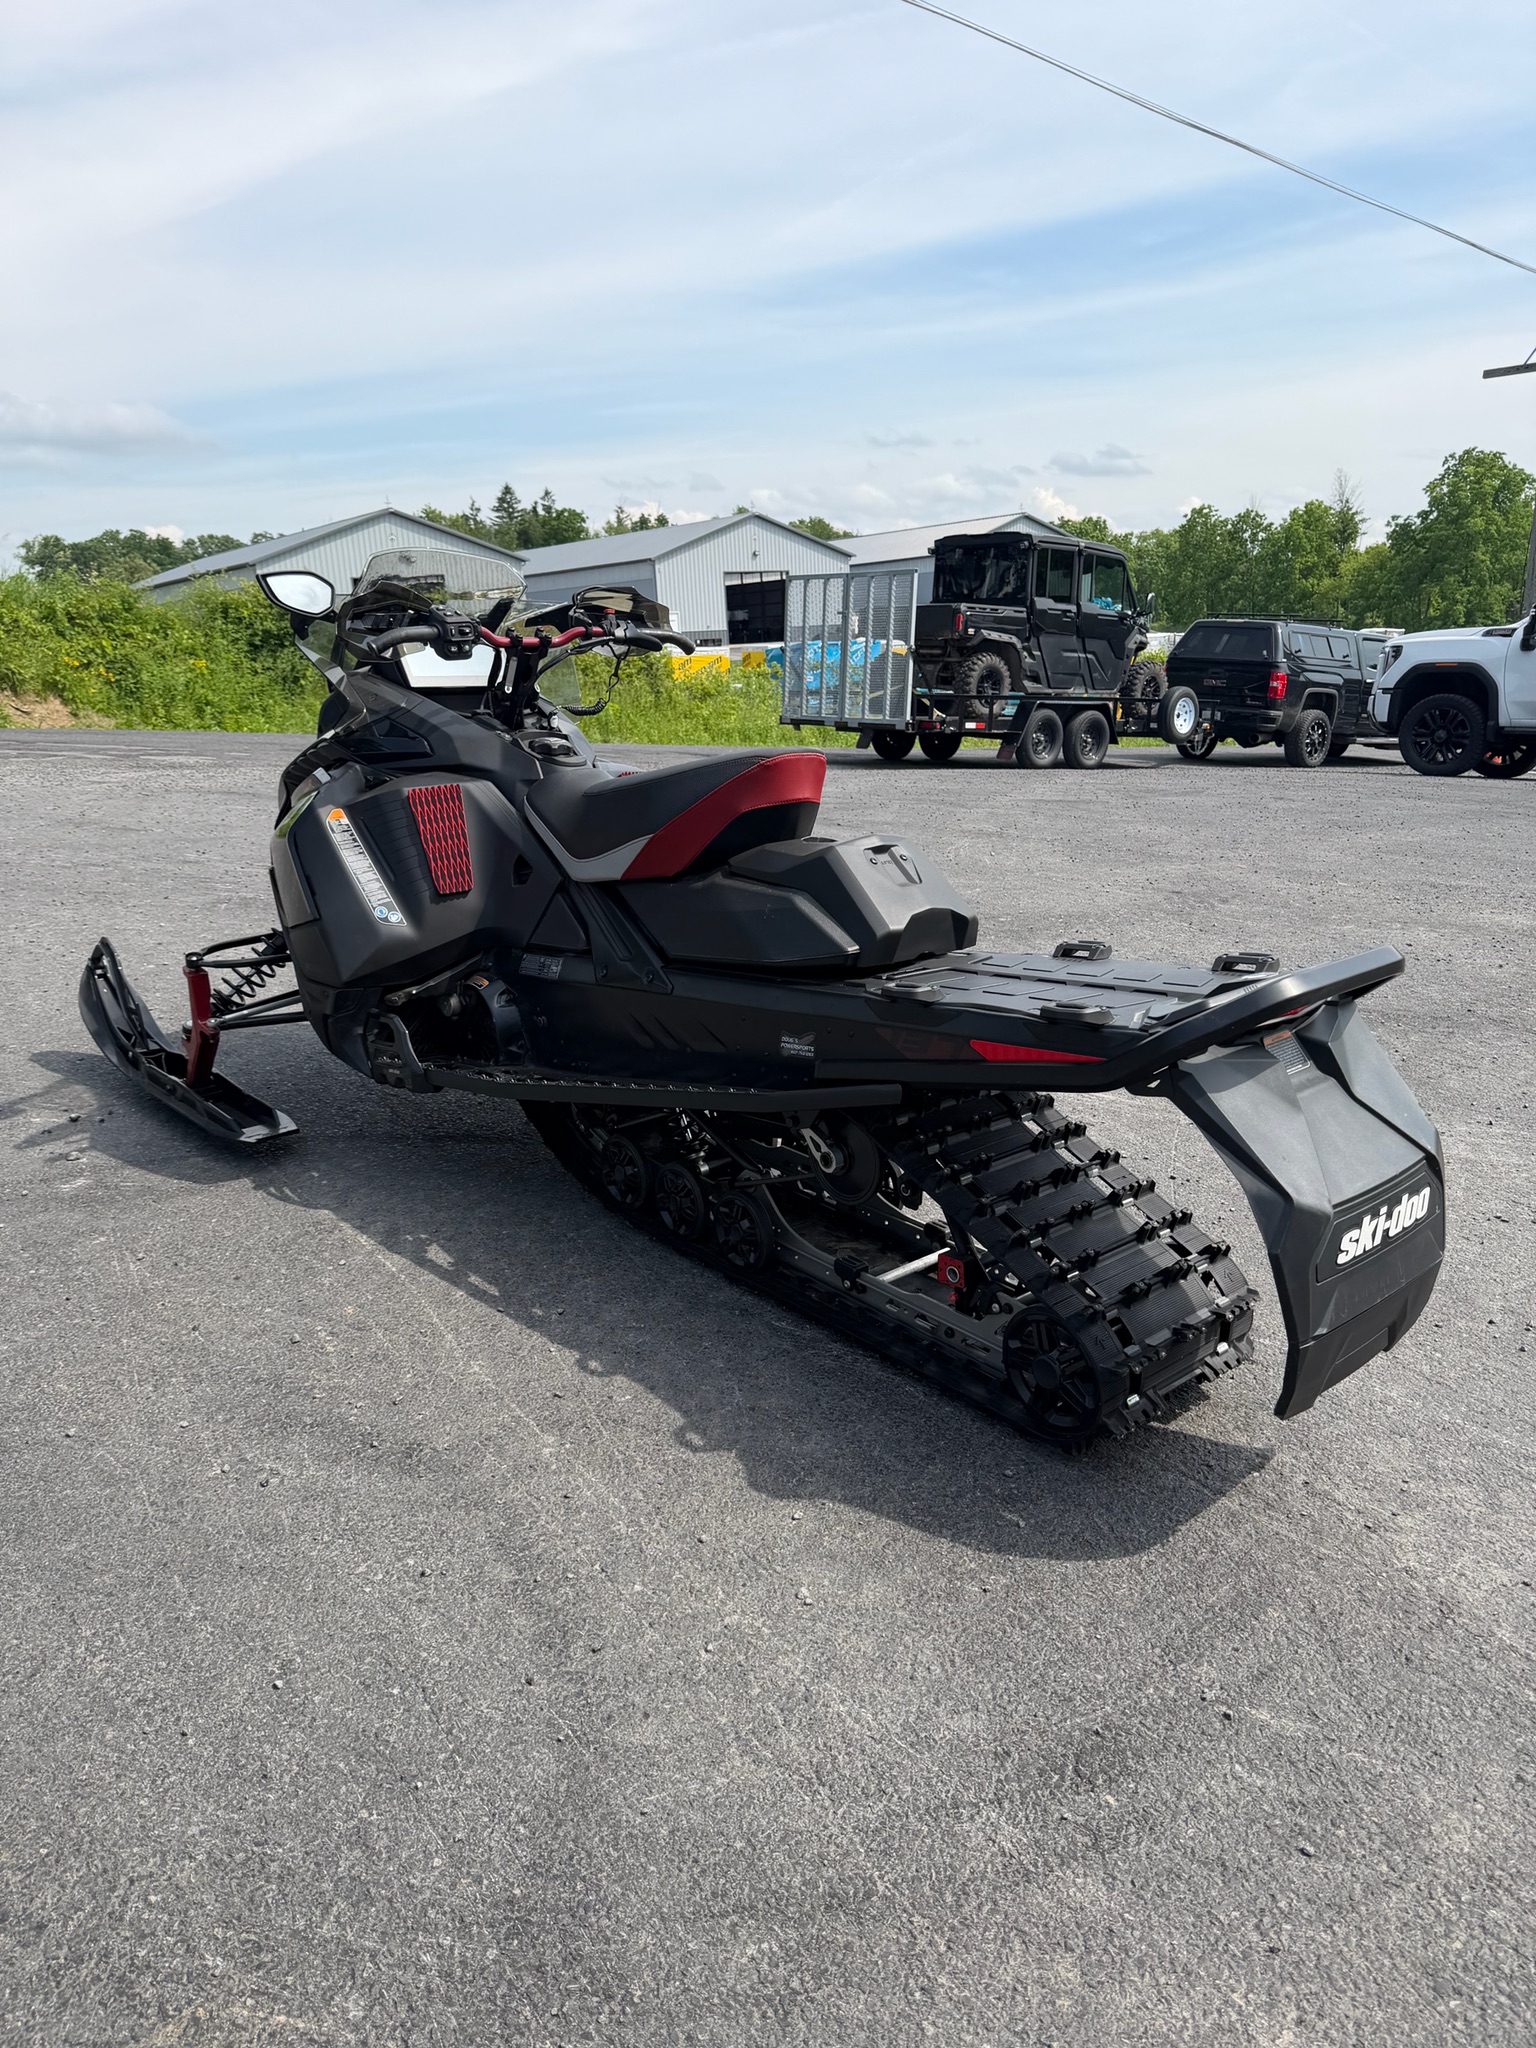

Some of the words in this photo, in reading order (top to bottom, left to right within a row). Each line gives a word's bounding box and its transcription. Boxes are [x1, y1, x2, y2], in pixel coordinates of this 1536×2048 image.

[1203, 679, 1227, 687] GMC
[780, 1042, 815, 1052] POWERSPORTS
[1336, 1186, 1431, 1265] ski-doo
